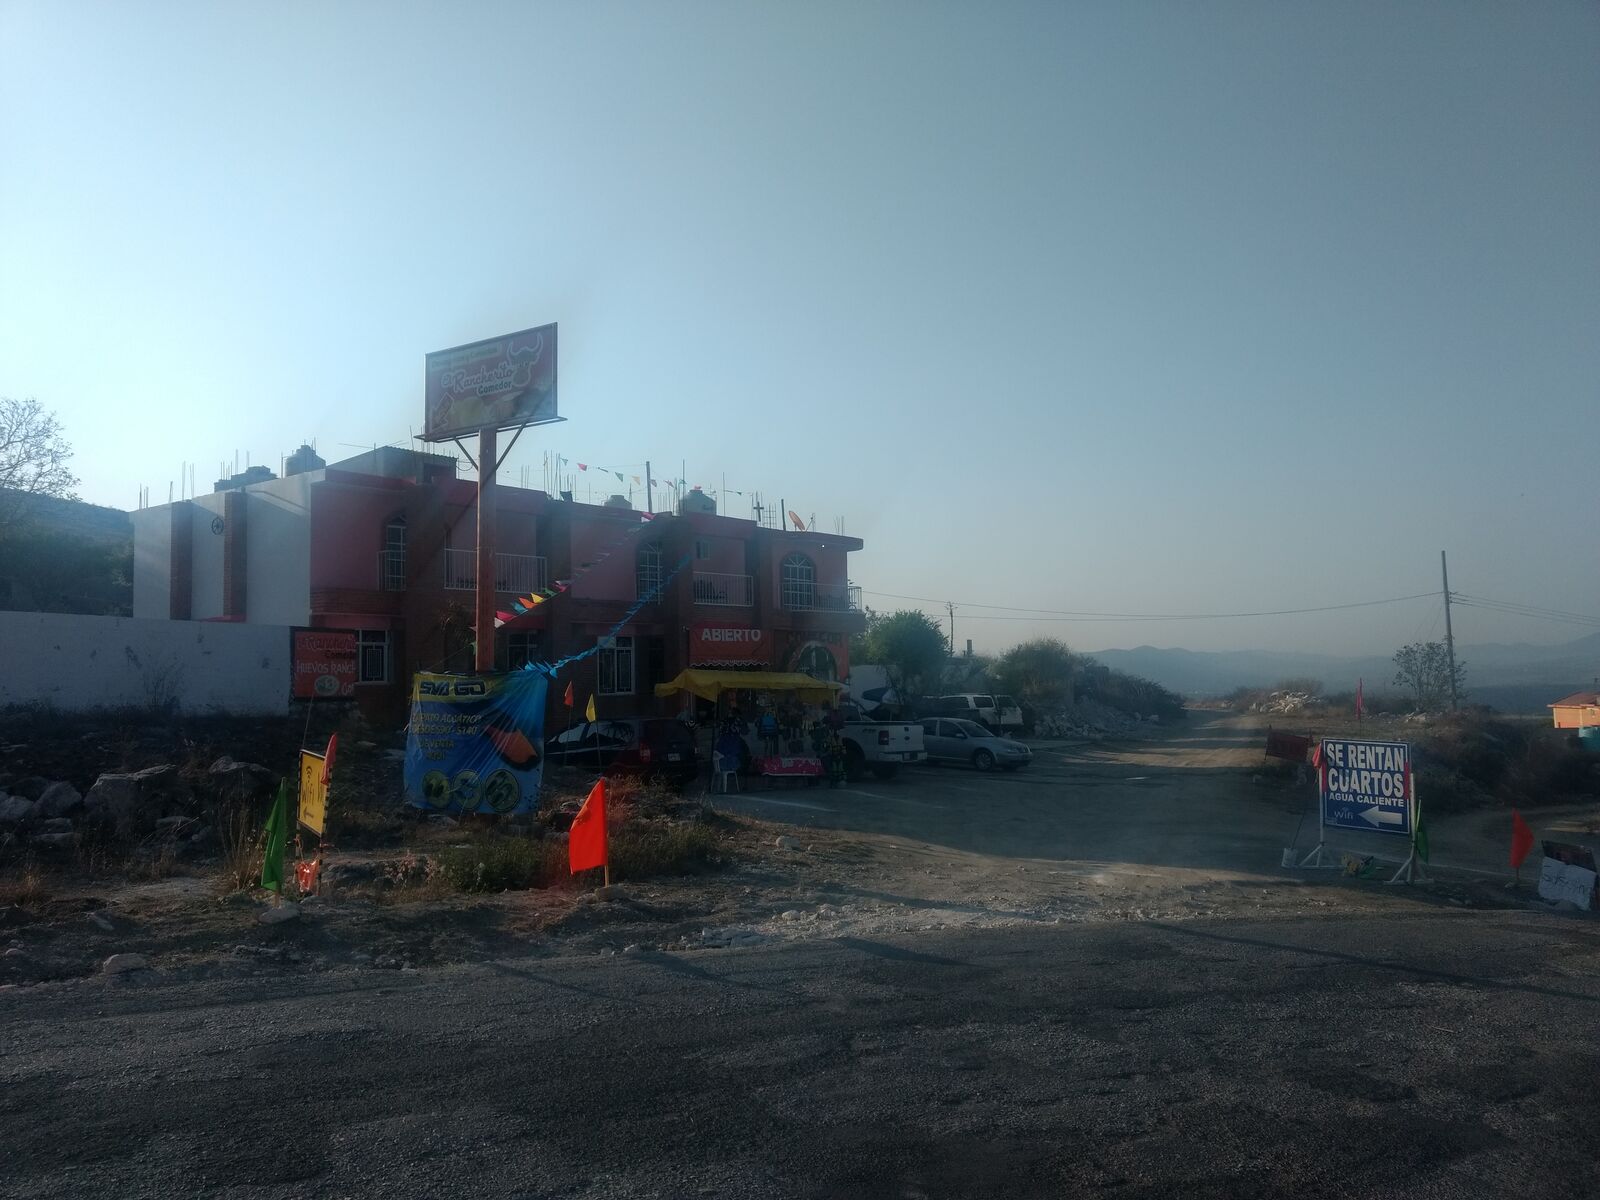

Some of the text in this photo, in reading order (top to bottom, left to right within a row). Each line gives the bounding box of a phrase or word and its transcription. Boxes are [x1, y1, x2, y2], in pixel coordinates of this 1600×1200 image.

[453, 362, 514, 392] Rancherito
[478, 381, 513, 396] Comedor
[701, 628, 762, 642] ABIERTO
[296, 660, 329, 674] HUEVOS
[1326, 743, 1404, 772] SE RENTAN
[1328, 768, 1405, 798] CUARTOS
[1329, 793, 1405, 808] AGUA CALIENTE
